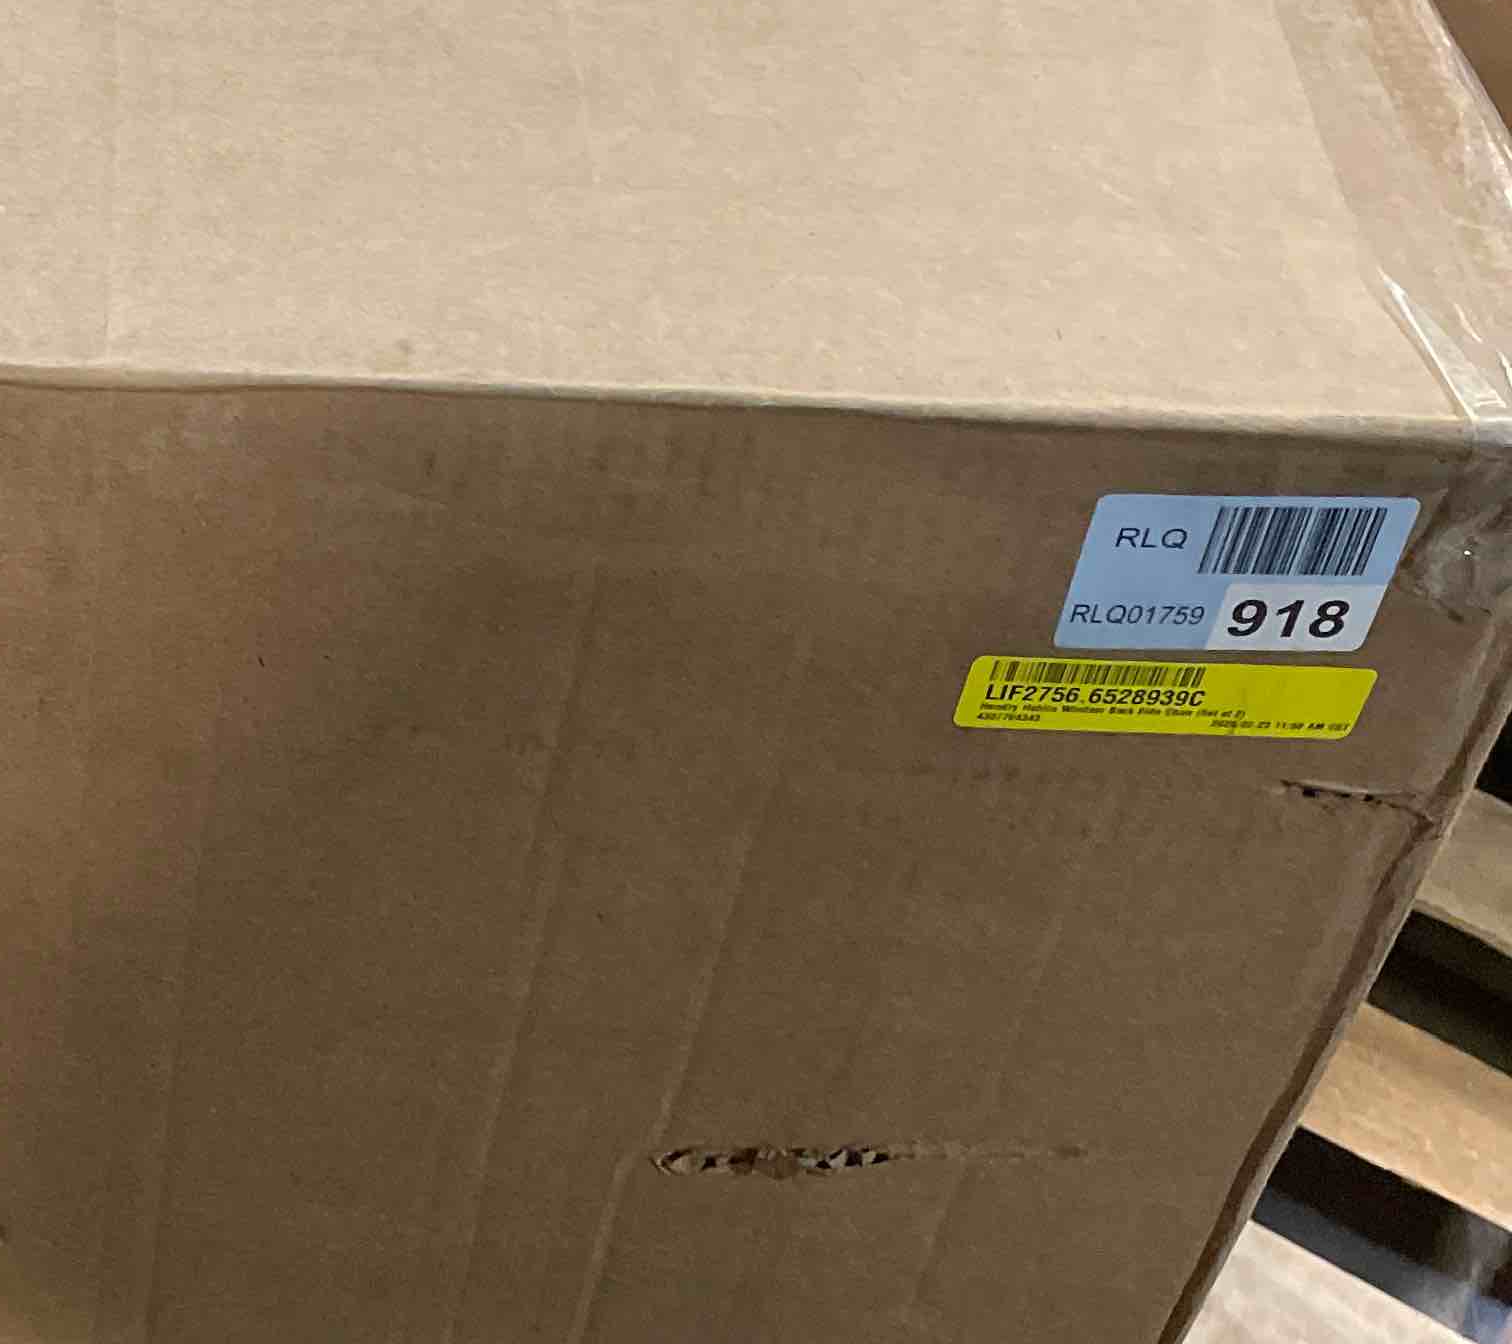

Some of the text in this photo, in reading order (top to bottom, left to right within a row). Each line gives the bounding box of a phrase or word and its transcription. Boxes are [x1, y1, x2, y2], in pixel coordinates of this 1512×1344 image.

[1114, 527, 1189, 550] RLQ
[1069, 604, 1205, 625] RLQ01759
[1227, 599, 1350, 639] 918
[985, 683, 1206, 707] LIF2756.6528939C
